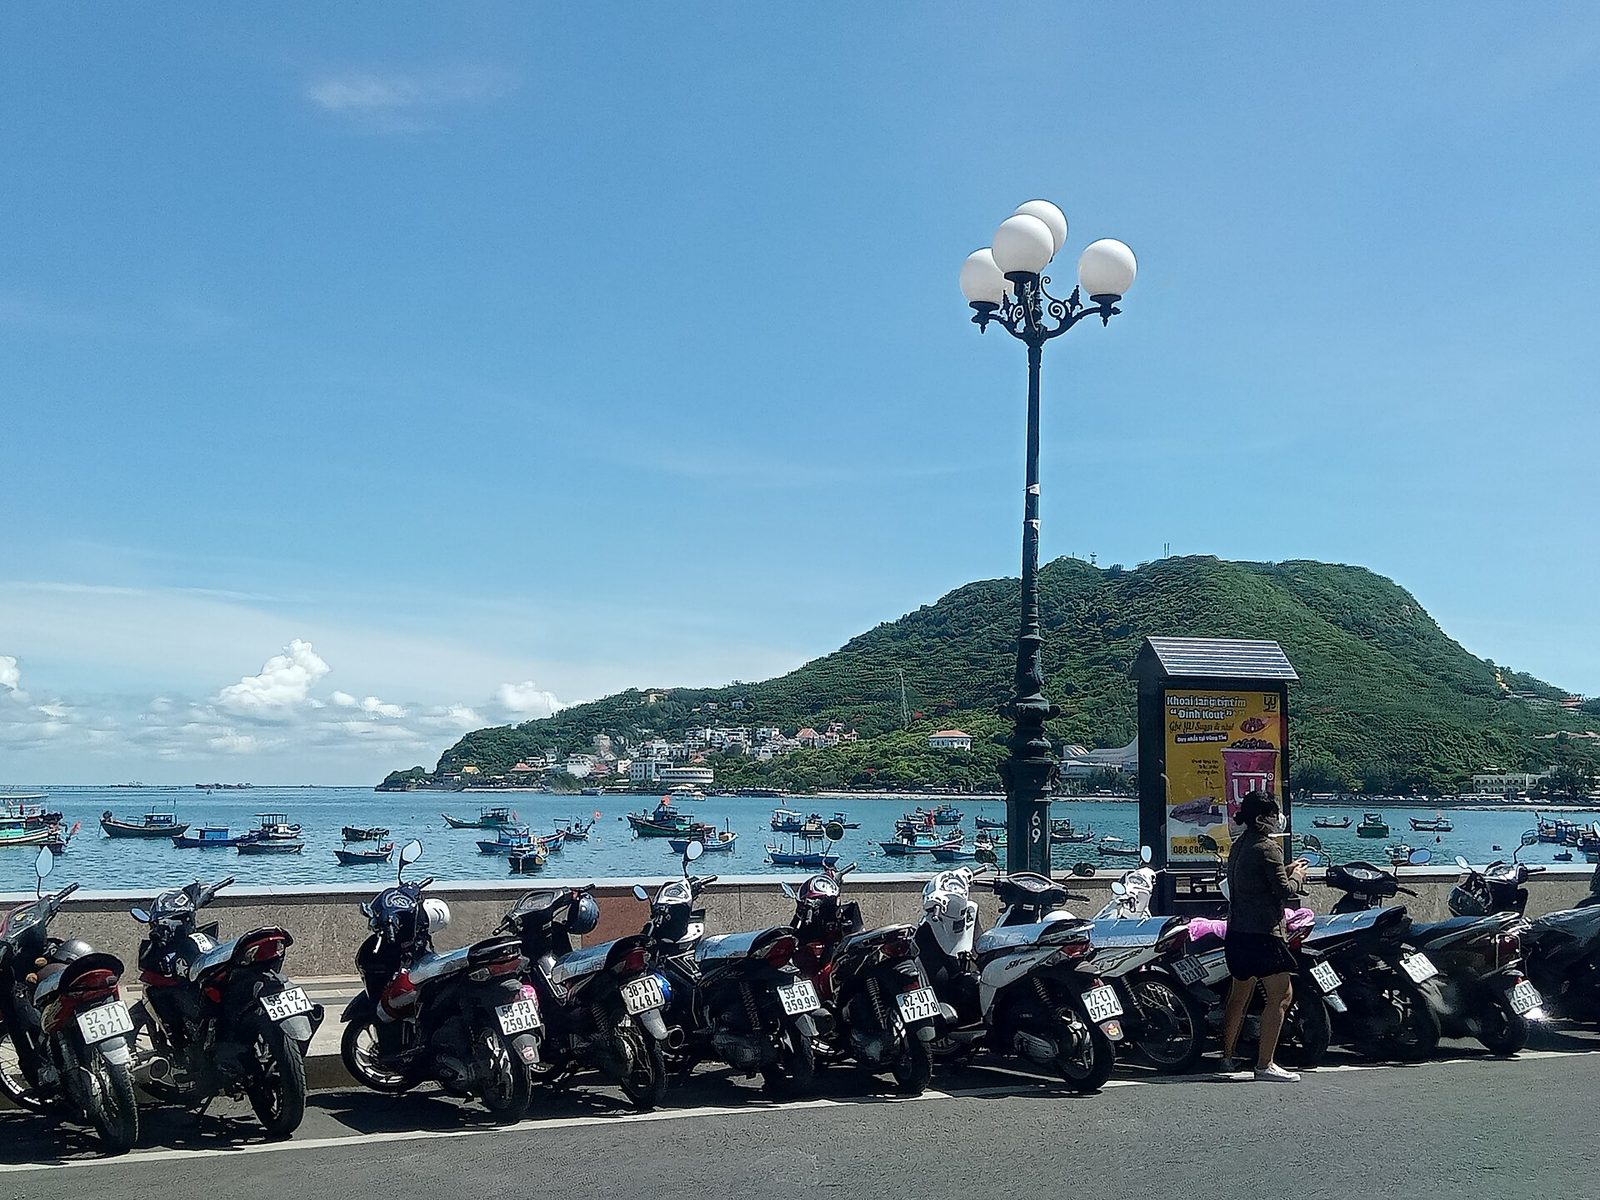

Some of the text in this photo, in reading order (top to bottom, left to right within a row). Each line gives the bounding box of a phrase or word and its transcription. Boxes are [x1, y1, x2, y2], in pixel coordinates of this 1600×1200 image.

[1166, 695, 1193, 706] Khoai
[632, 992, 660, 1011] 4484
[783, 984, 810, 1000] 59-G1
[269, 999, 309, 1019] 391.47
[89, 1018, 125, 1040] 5821
